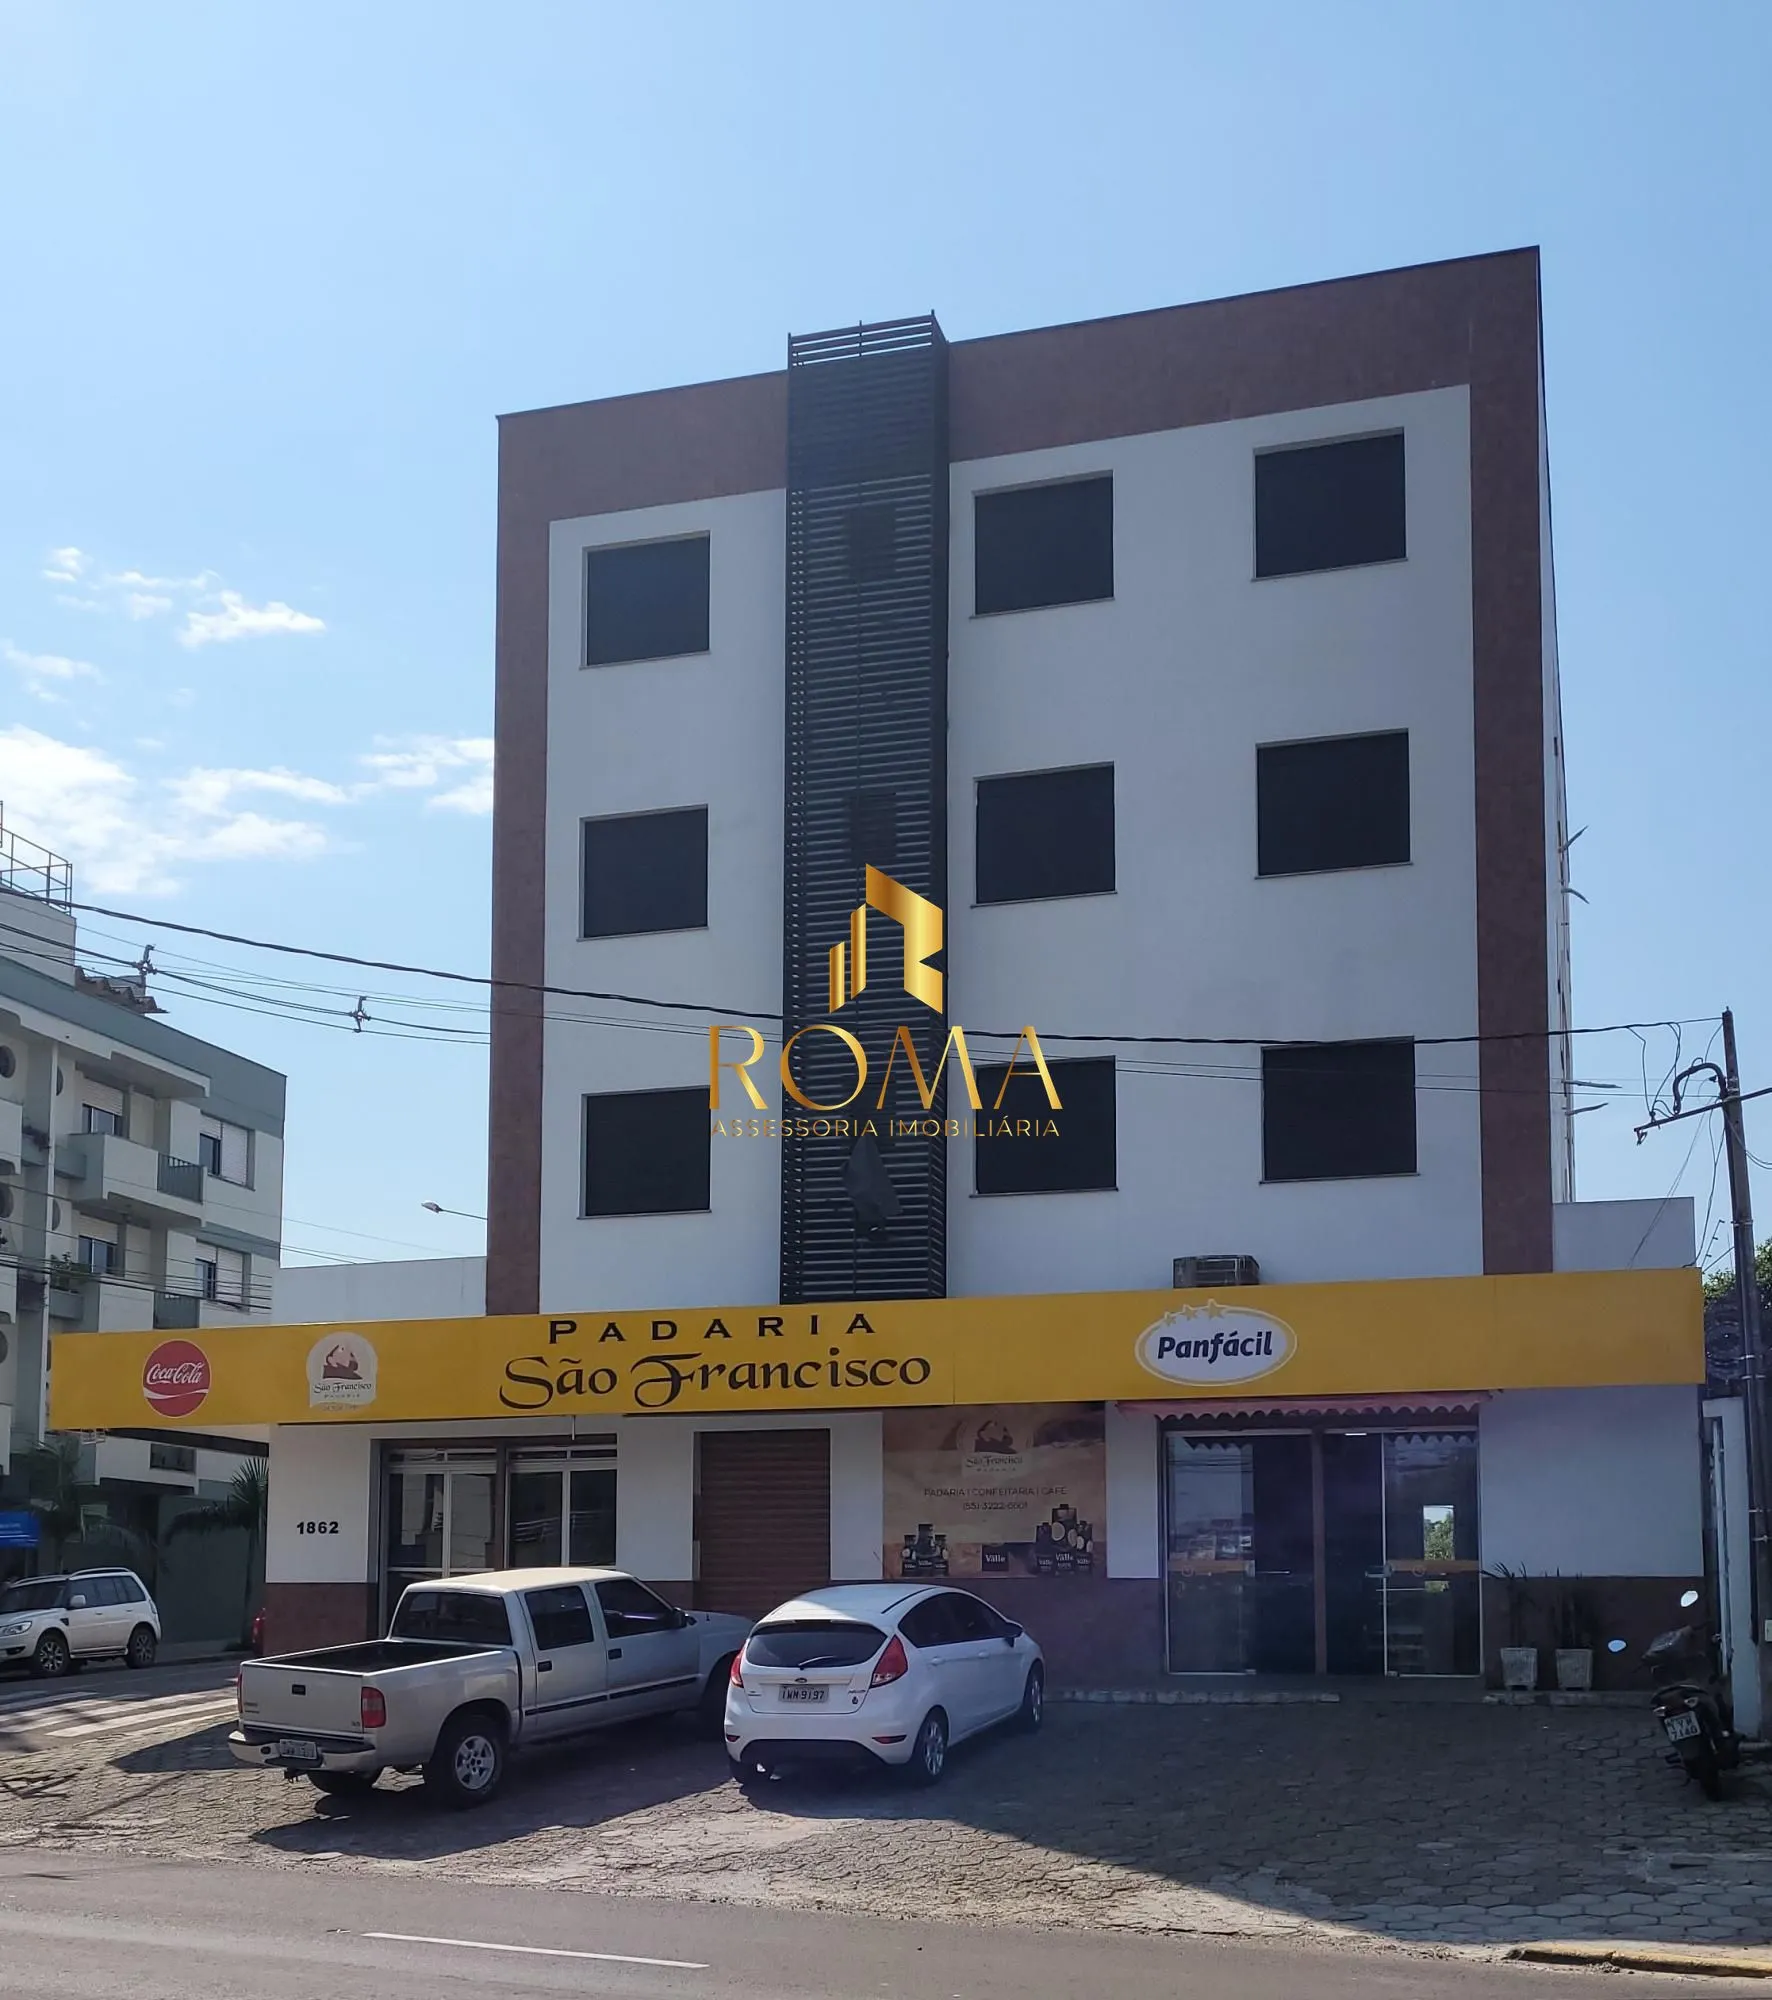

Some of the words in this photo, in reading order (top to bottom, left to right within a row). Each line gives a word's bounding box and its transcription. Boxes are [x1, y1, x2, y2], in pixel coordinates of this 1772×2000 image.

[549, 1313, 876, 1345] PADARIA
[1157, 1330, 1273, 1365] Panfácil
[146, 1362, 206, 1385] Coca-Cola
[499, 1356, 618, 1410] São
[630, 1347, 932, 1408] Francisco
[924, 1487, 965, 1497] PADARIA
[973, 1486, 1034, 1496] CONFEITARIA
[296, 1521, 339, 1535] 1862
